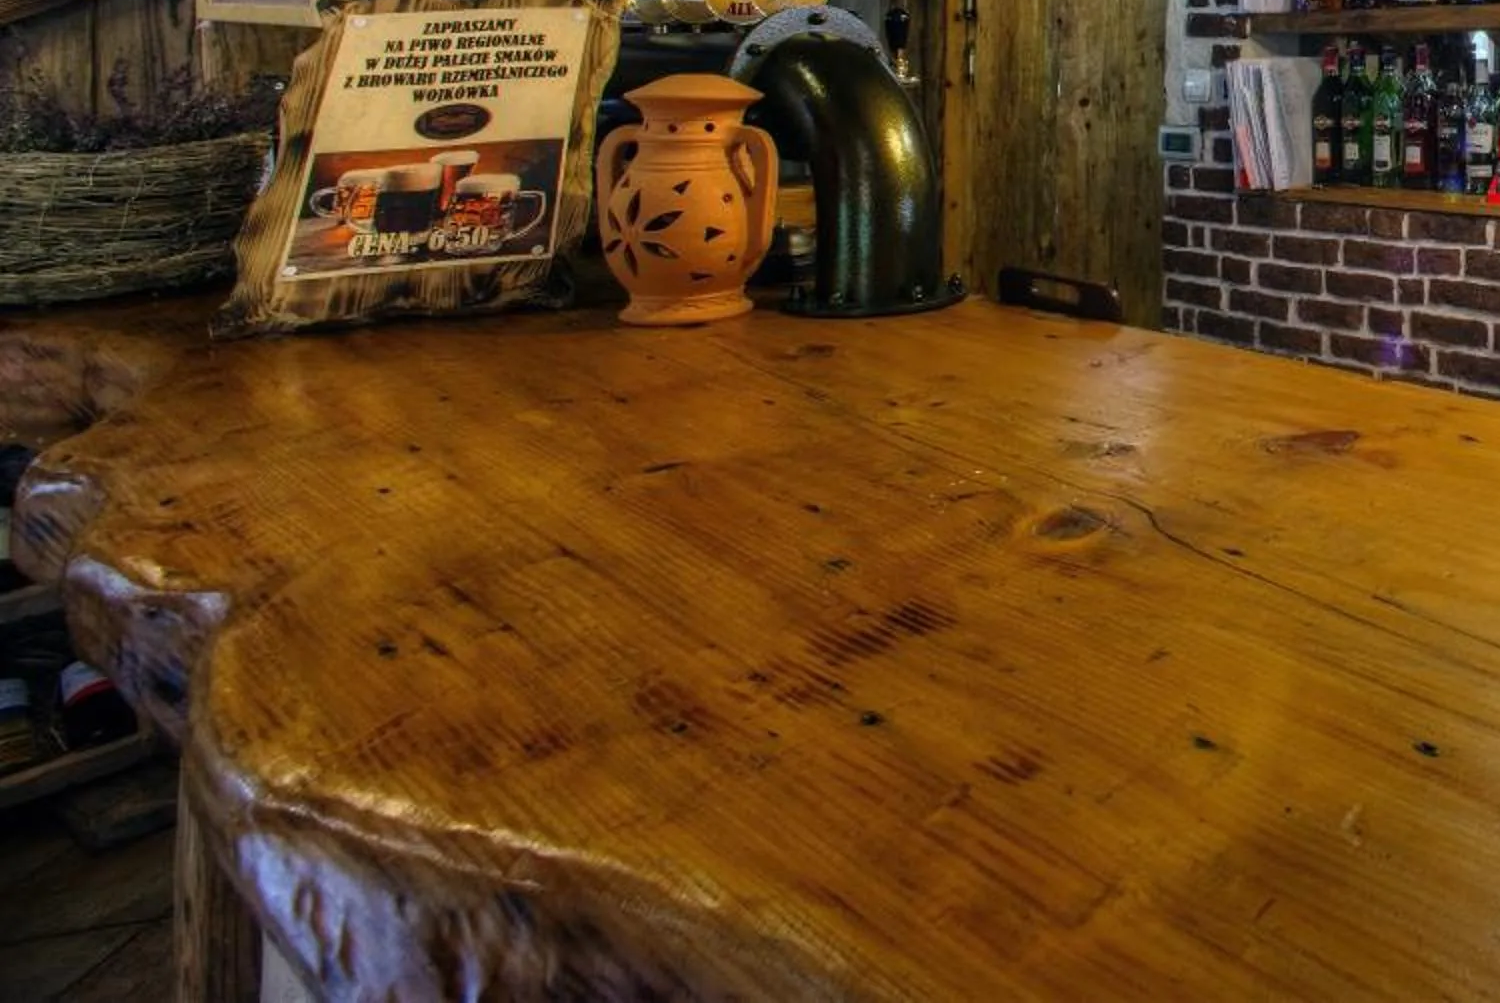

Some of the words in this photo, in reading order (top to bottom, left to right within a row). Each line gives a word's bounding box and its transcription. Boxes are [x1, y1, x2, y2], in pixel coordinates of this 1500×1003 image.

[423, 18, 518, 35] ZAPRASZAMY
[385, 40, 405, 53] NA
[409, 38, 452, 52] PIWO
[456, 34, 547, 50] REGIONALNE
[365, 57, 380, 71] W
[383, 54, 429, 70] DUŻEJ
[432, 52, 491, 68] PALECIE
[494, 48, 559, 64] SMAKÓW
[343, 76, 354, 89] Z
[356, 72, 438, 88] BROWARU
[441, 64, 569, 84] RZEMIEŚLNICZEGO
[412, 85, 499, 103] WOJKÓWKA
